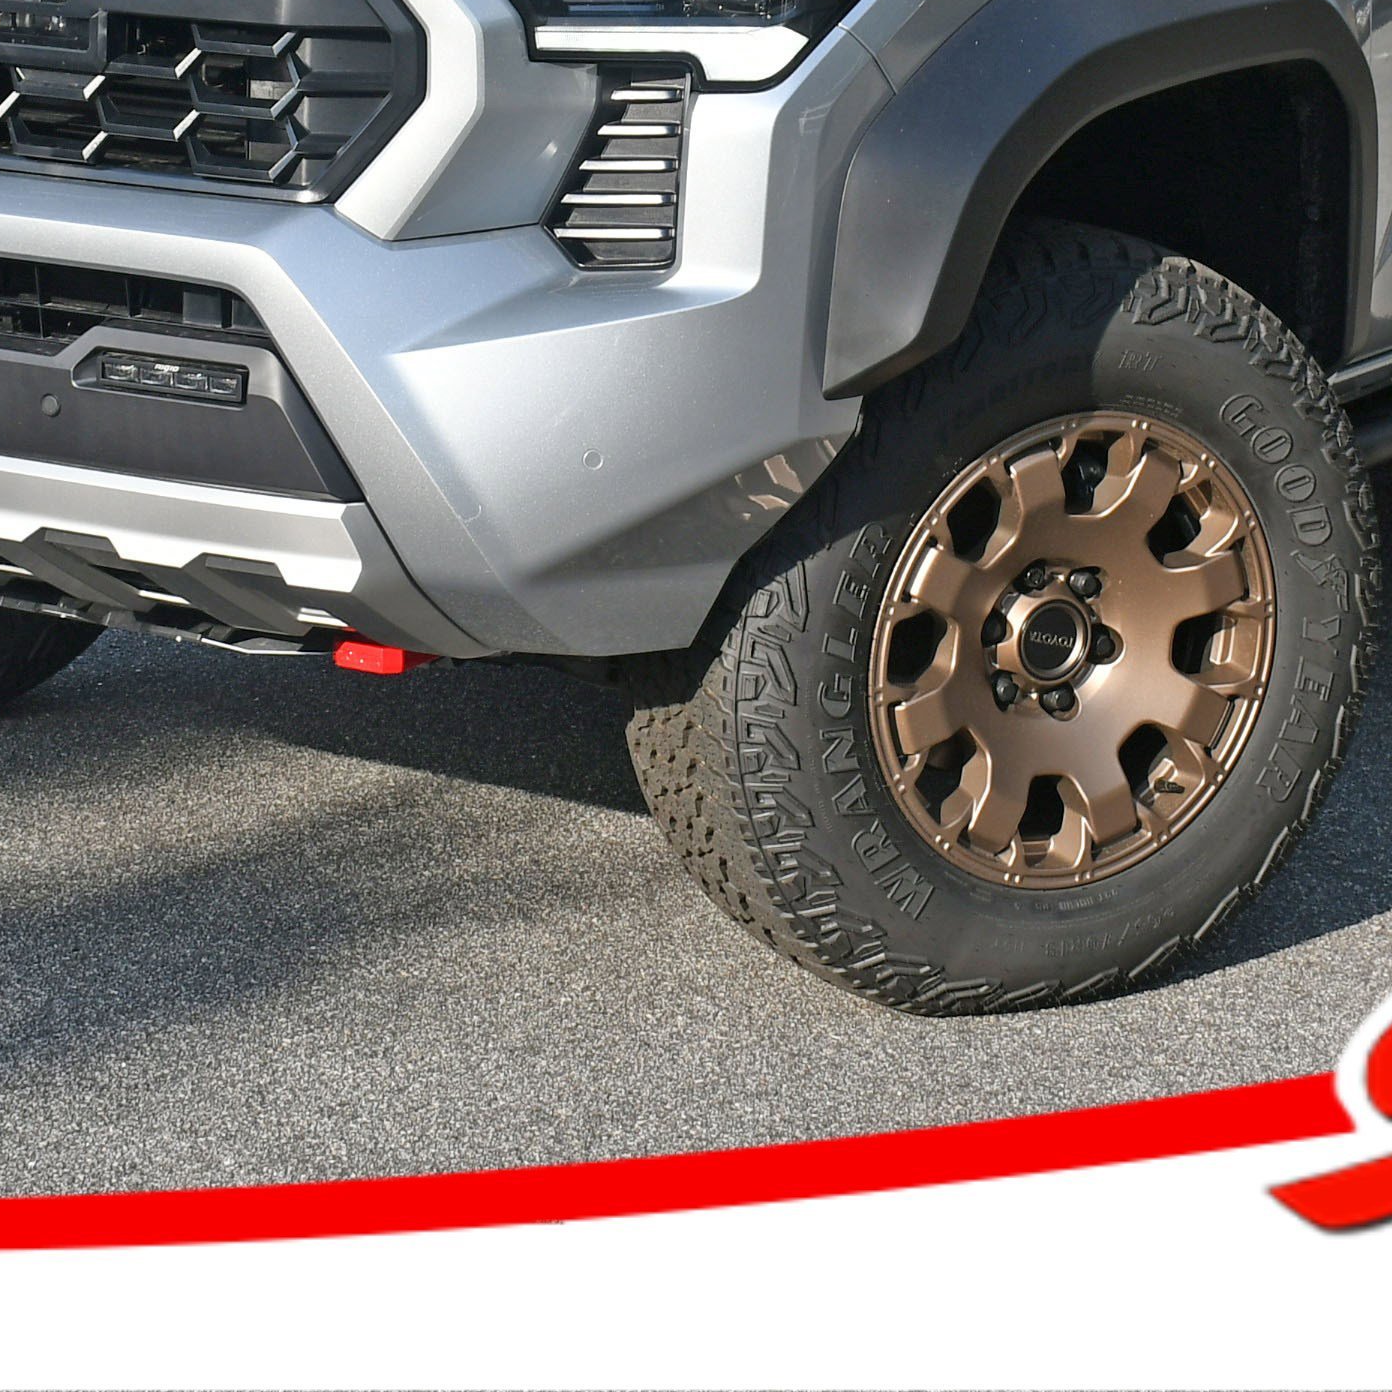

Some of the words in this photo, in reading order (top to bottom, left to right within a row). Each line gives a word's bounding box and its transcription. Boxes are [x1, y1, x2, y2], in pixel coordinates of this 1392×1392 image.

[817, 520, 936, 912] WRANGLER
[1029, 630, 1075, 649] TOYOTA
[1218, 393, 1339, 804] GOODYEAR
